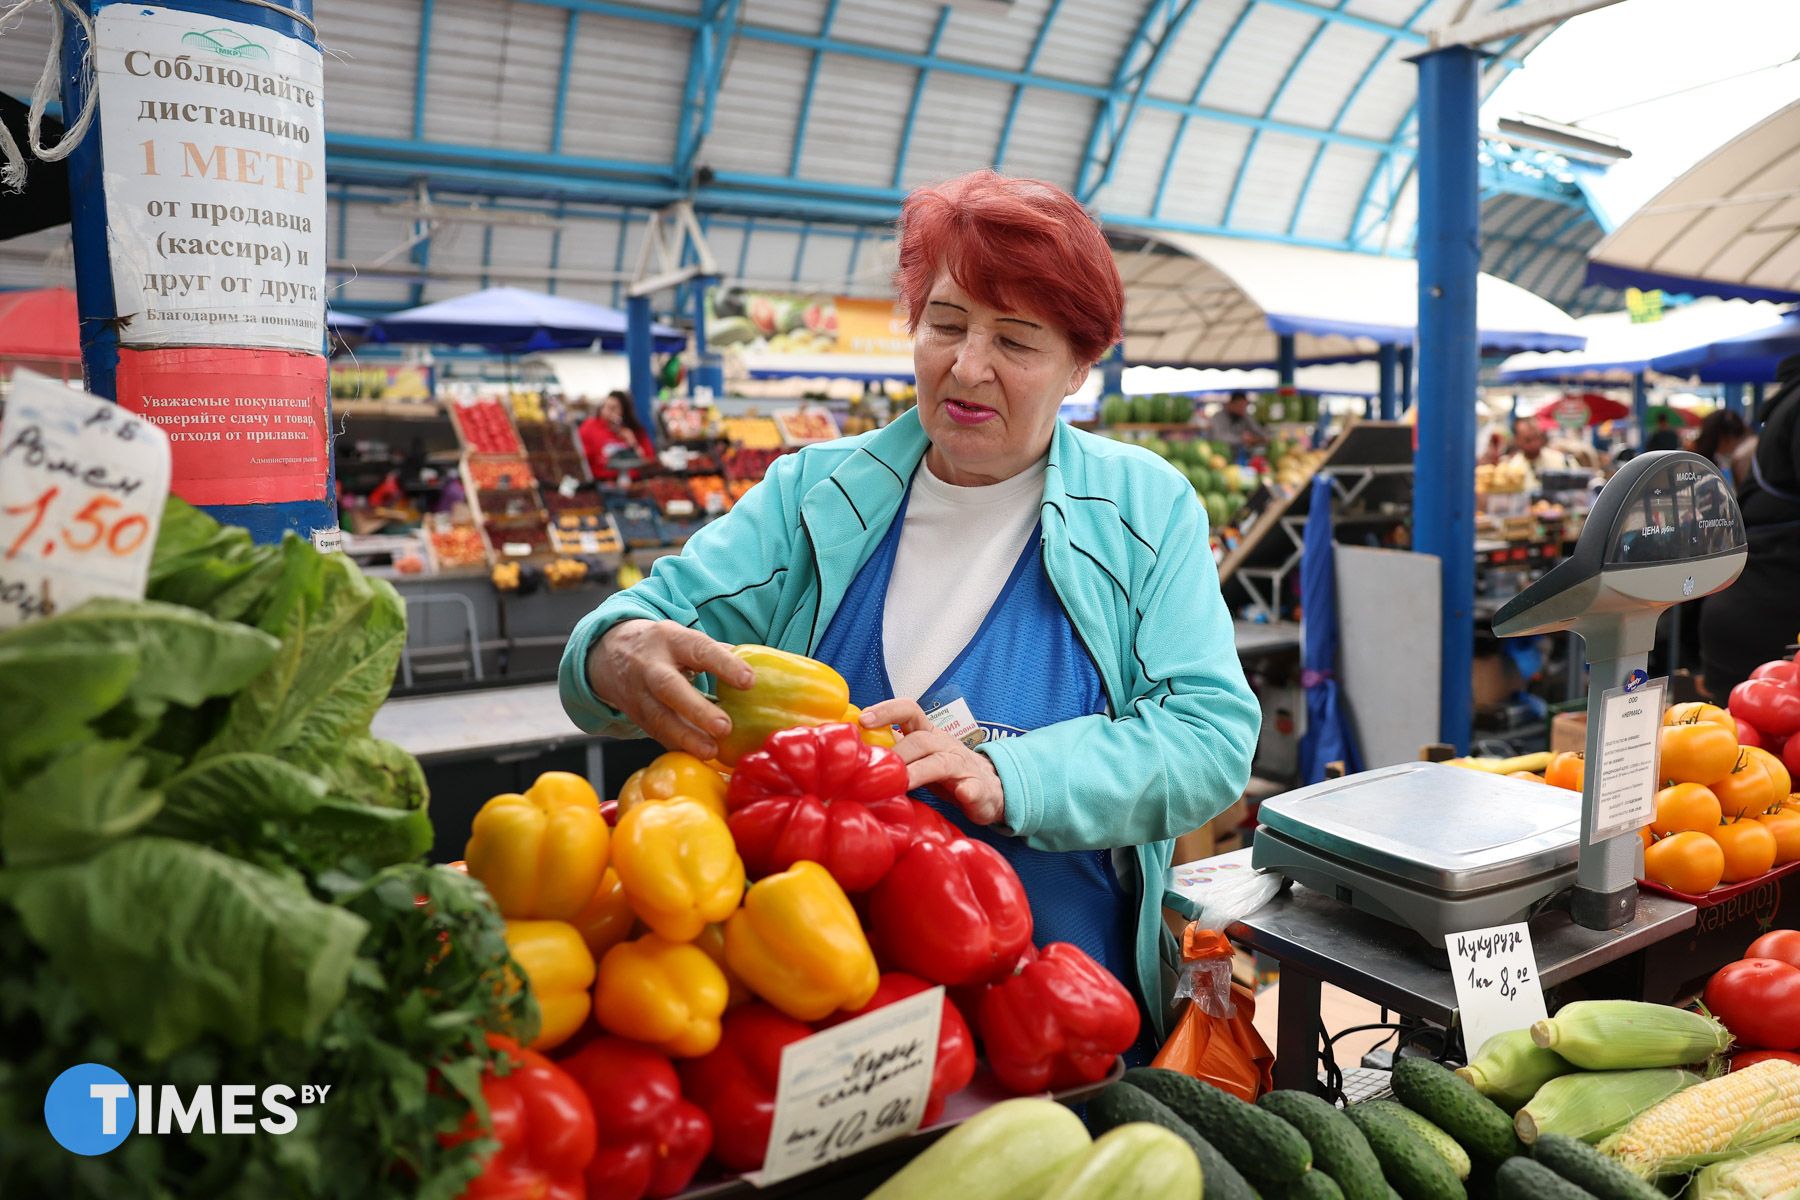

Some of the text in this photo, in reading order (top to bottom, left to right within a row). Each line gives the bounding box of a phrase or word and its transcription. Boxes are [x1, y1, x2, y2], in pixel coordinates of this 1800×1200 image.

[124, 49, 315, 108] Соблюдайте
[137, 99, 310, 144] дистанцию
[138, 139, 314, 194] 1 МЕТР
[147, 200, 312, 234] от продавца
[156, 231, 309, 269] (кассира) и
[143, 273, 317, 304] друг от друга
[147, 308, 238, 325] Благодарим
[242, 313, 257, 324] за
[142, 395, 311, 411] Уважаемые покупатели!
[230, 412, 270, 427] сдачу
[274, 414, 282, 424] и
[284, 414, 316, 427] товар,
[170, 430, 309, 443] отходя от прилавка.
[1642, 525, 1660, 538] ЦЕНА
[928, 708, 950, 721] давец
[1457, 931, 1523, 962] Кукуруза
